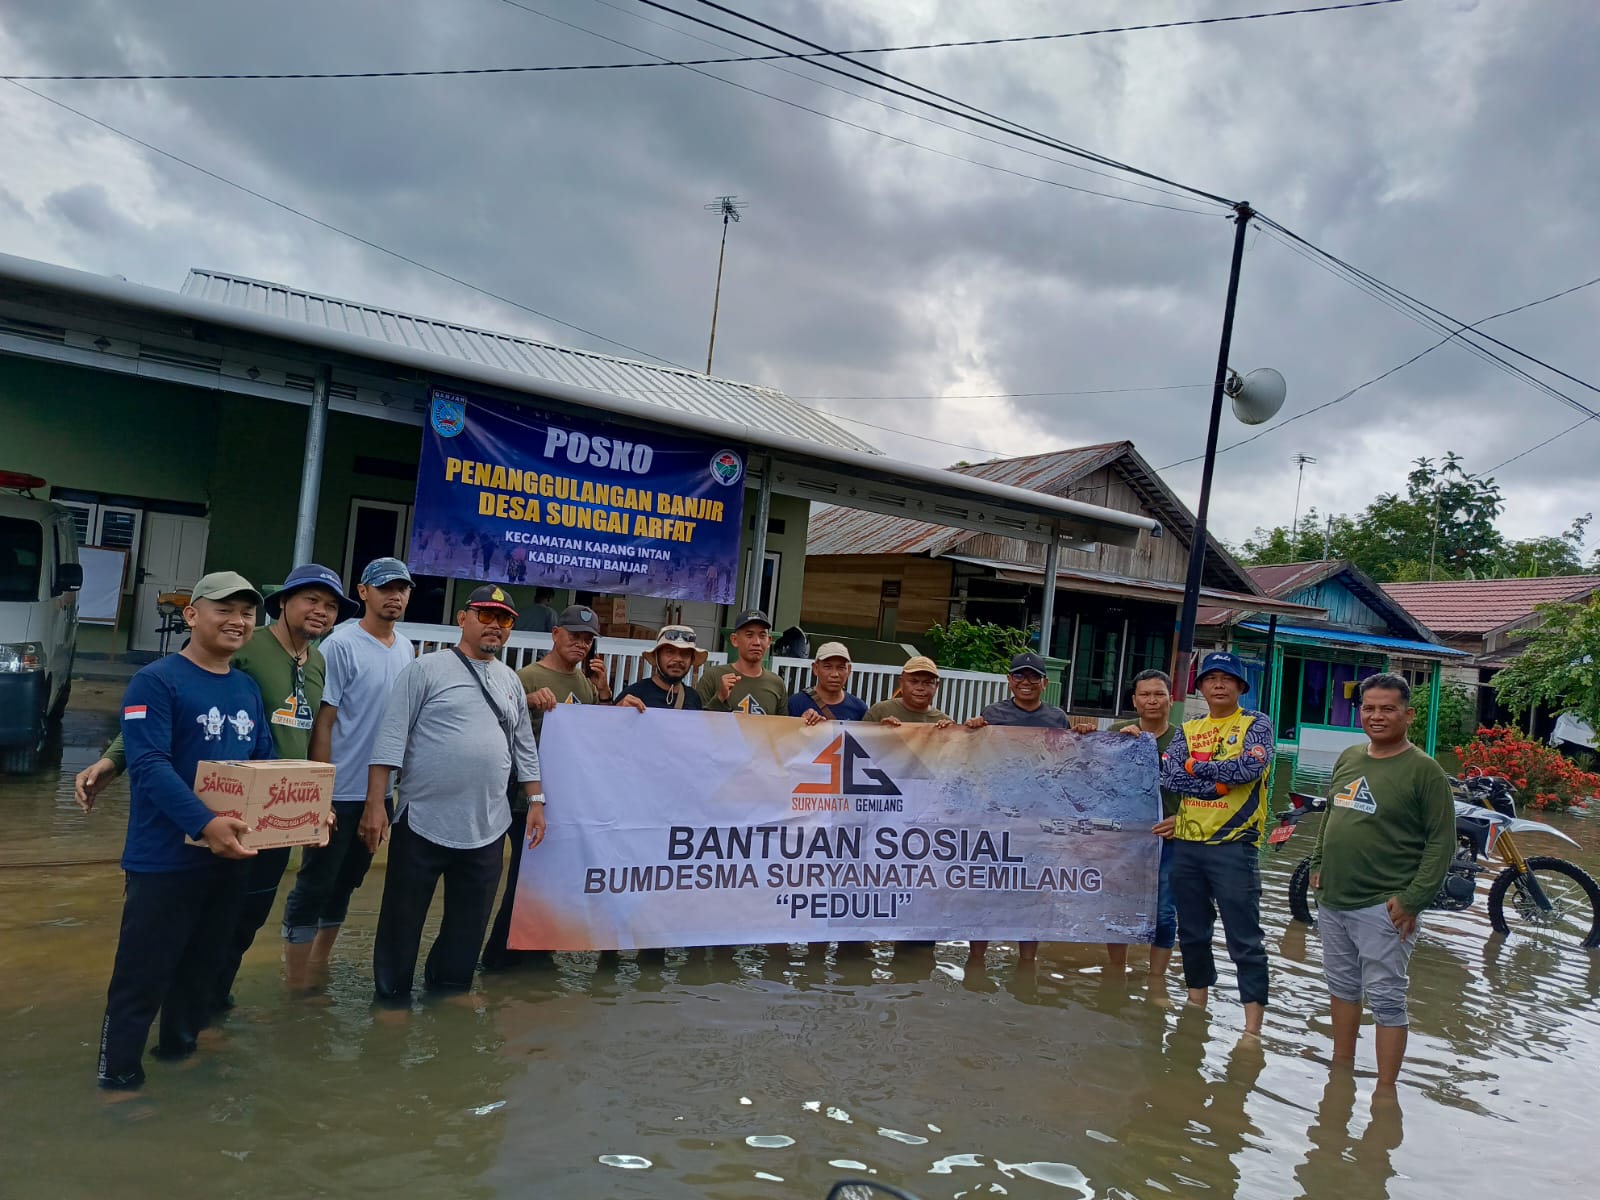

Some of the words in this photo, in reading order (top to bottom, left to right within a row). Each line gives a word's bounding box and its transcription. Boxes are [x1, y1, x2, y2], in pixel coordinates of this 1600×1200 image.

[543, 426, 654, 475] POSKO
[445, 456, 653, 512] PENANGGULANGAN
[656, 493, 724, 522] BANJIR
[478, 491, 541, 523] DESA
[546, 502, 629, 535] SUNGAI
[633, 515, 697, 543] ARFAT
[505, 530, 583, 551] KECAMATAN
[584, 541, 636, 558] KARANG
[637, 547, 671, 561] INTAN
[528, 551, 601, 570] KABUPATEN
[603, 559, 649, 575] BANJAR
[791, 797, 850, 812] SURYANATA
[855, 799, 904, 813] GEMILANG
[667, 825, 861, 862] BANTUAN
[874, 827, 1024, 863] SOSIAL
[583, 863, 759, 894] BUMDESMA
[766, 863, 937, 889] SURYANATA
[945, 864, 1102, 892] GEMILANG
